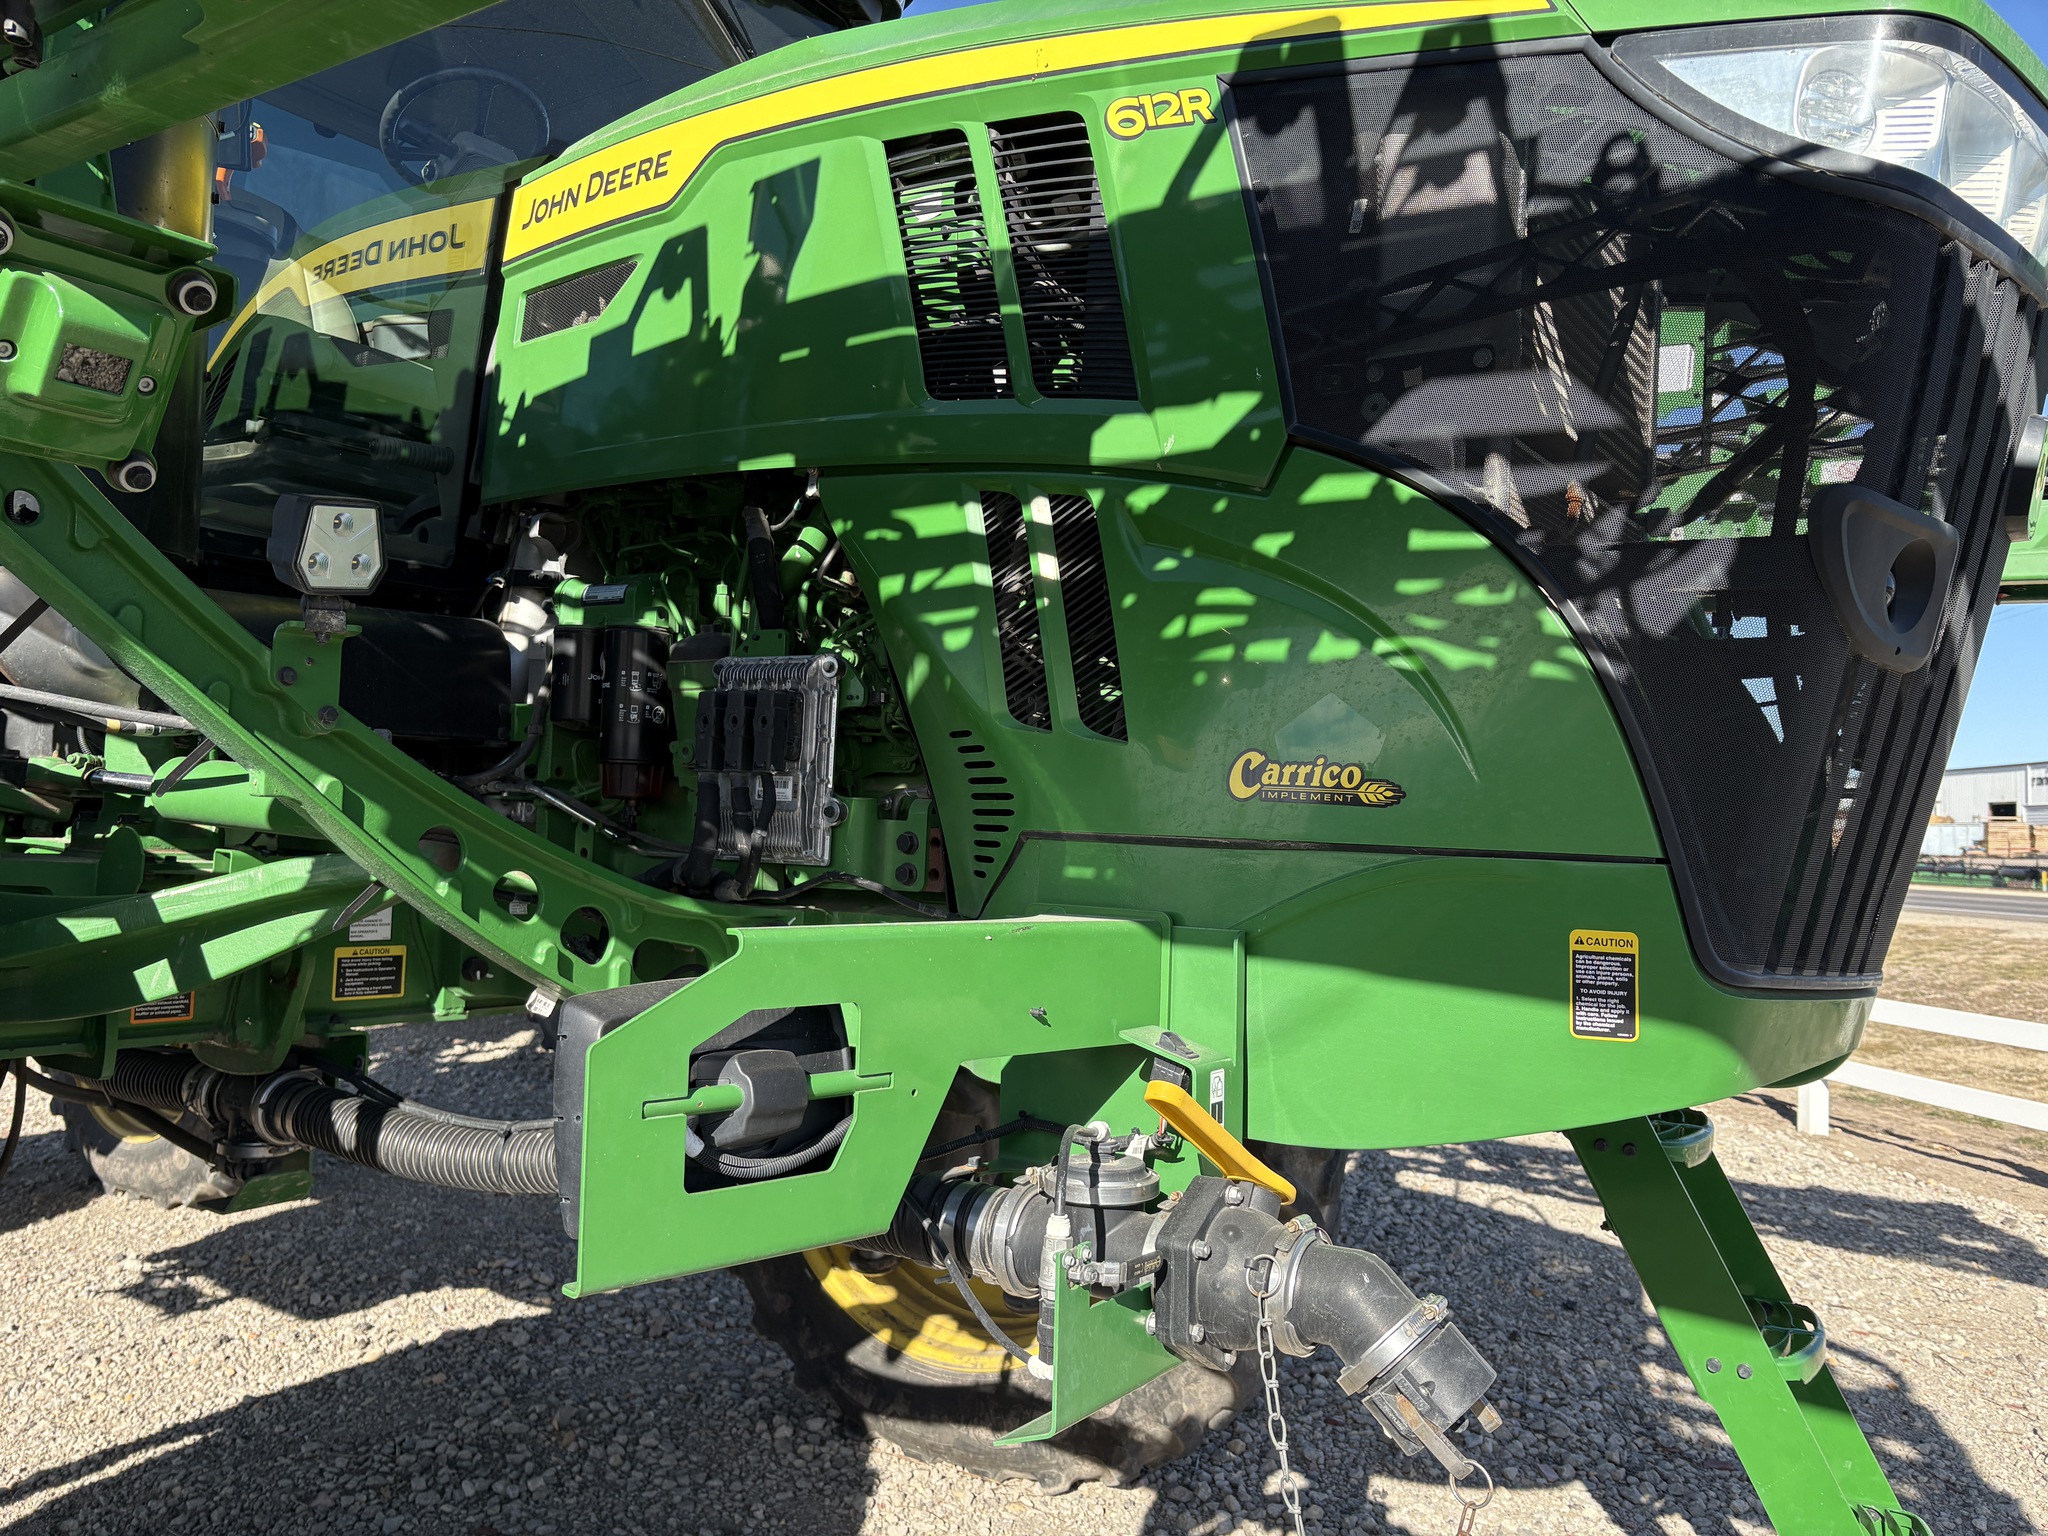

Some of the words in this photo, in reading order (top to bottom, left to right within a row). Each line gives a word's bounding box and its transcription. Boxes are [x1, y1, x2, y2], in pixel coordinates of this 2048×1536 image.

[1104, 87, 1218, 141] 612R
[522, 183, 582, 230] JOHN
[585, 150, 672, 203] DEERE
[1229, 751, 1362, 799] Carrico
[1262, 791, 1354, 802] IMPLEMENT
[1586, 937, 1633, 948] CAUTION
